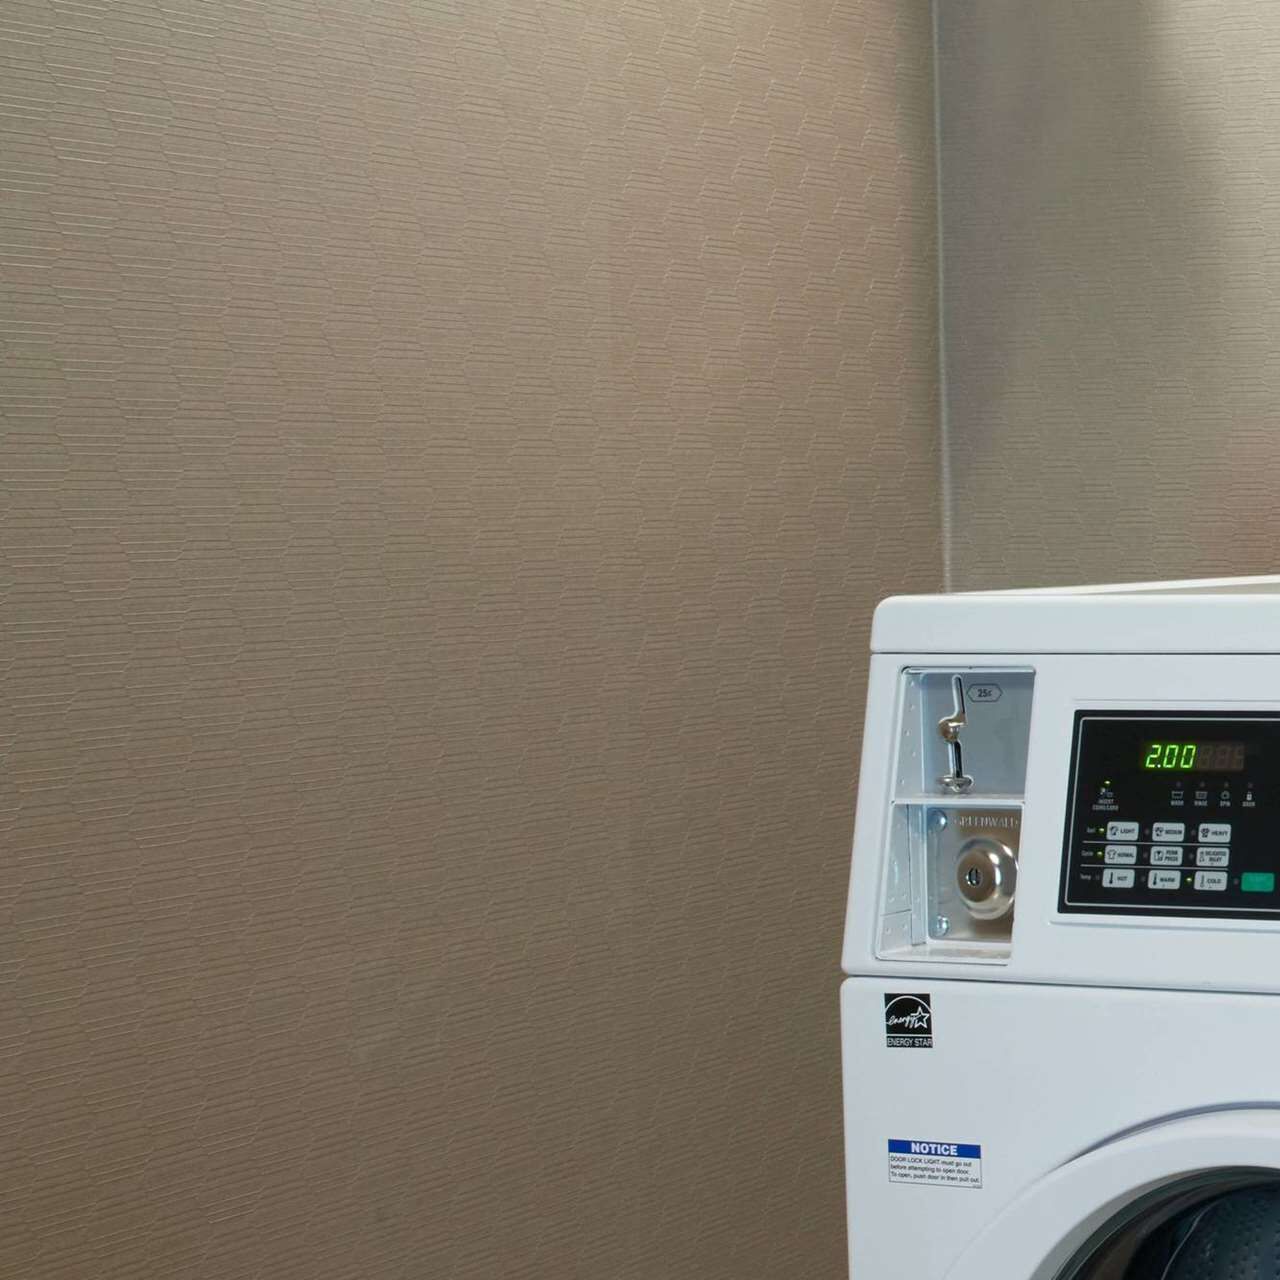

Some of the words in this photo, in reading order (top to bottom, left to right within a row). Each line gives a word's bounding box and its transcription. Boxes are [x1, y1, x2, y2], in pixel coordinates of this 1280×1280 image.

[1145, 745, 1196, 768] 2.00
[888, 1038, 913, 1046] ENERGY
[915, 1038, 933, 1047] STAR
[911, 1142, 958, 1155] NOTICE
